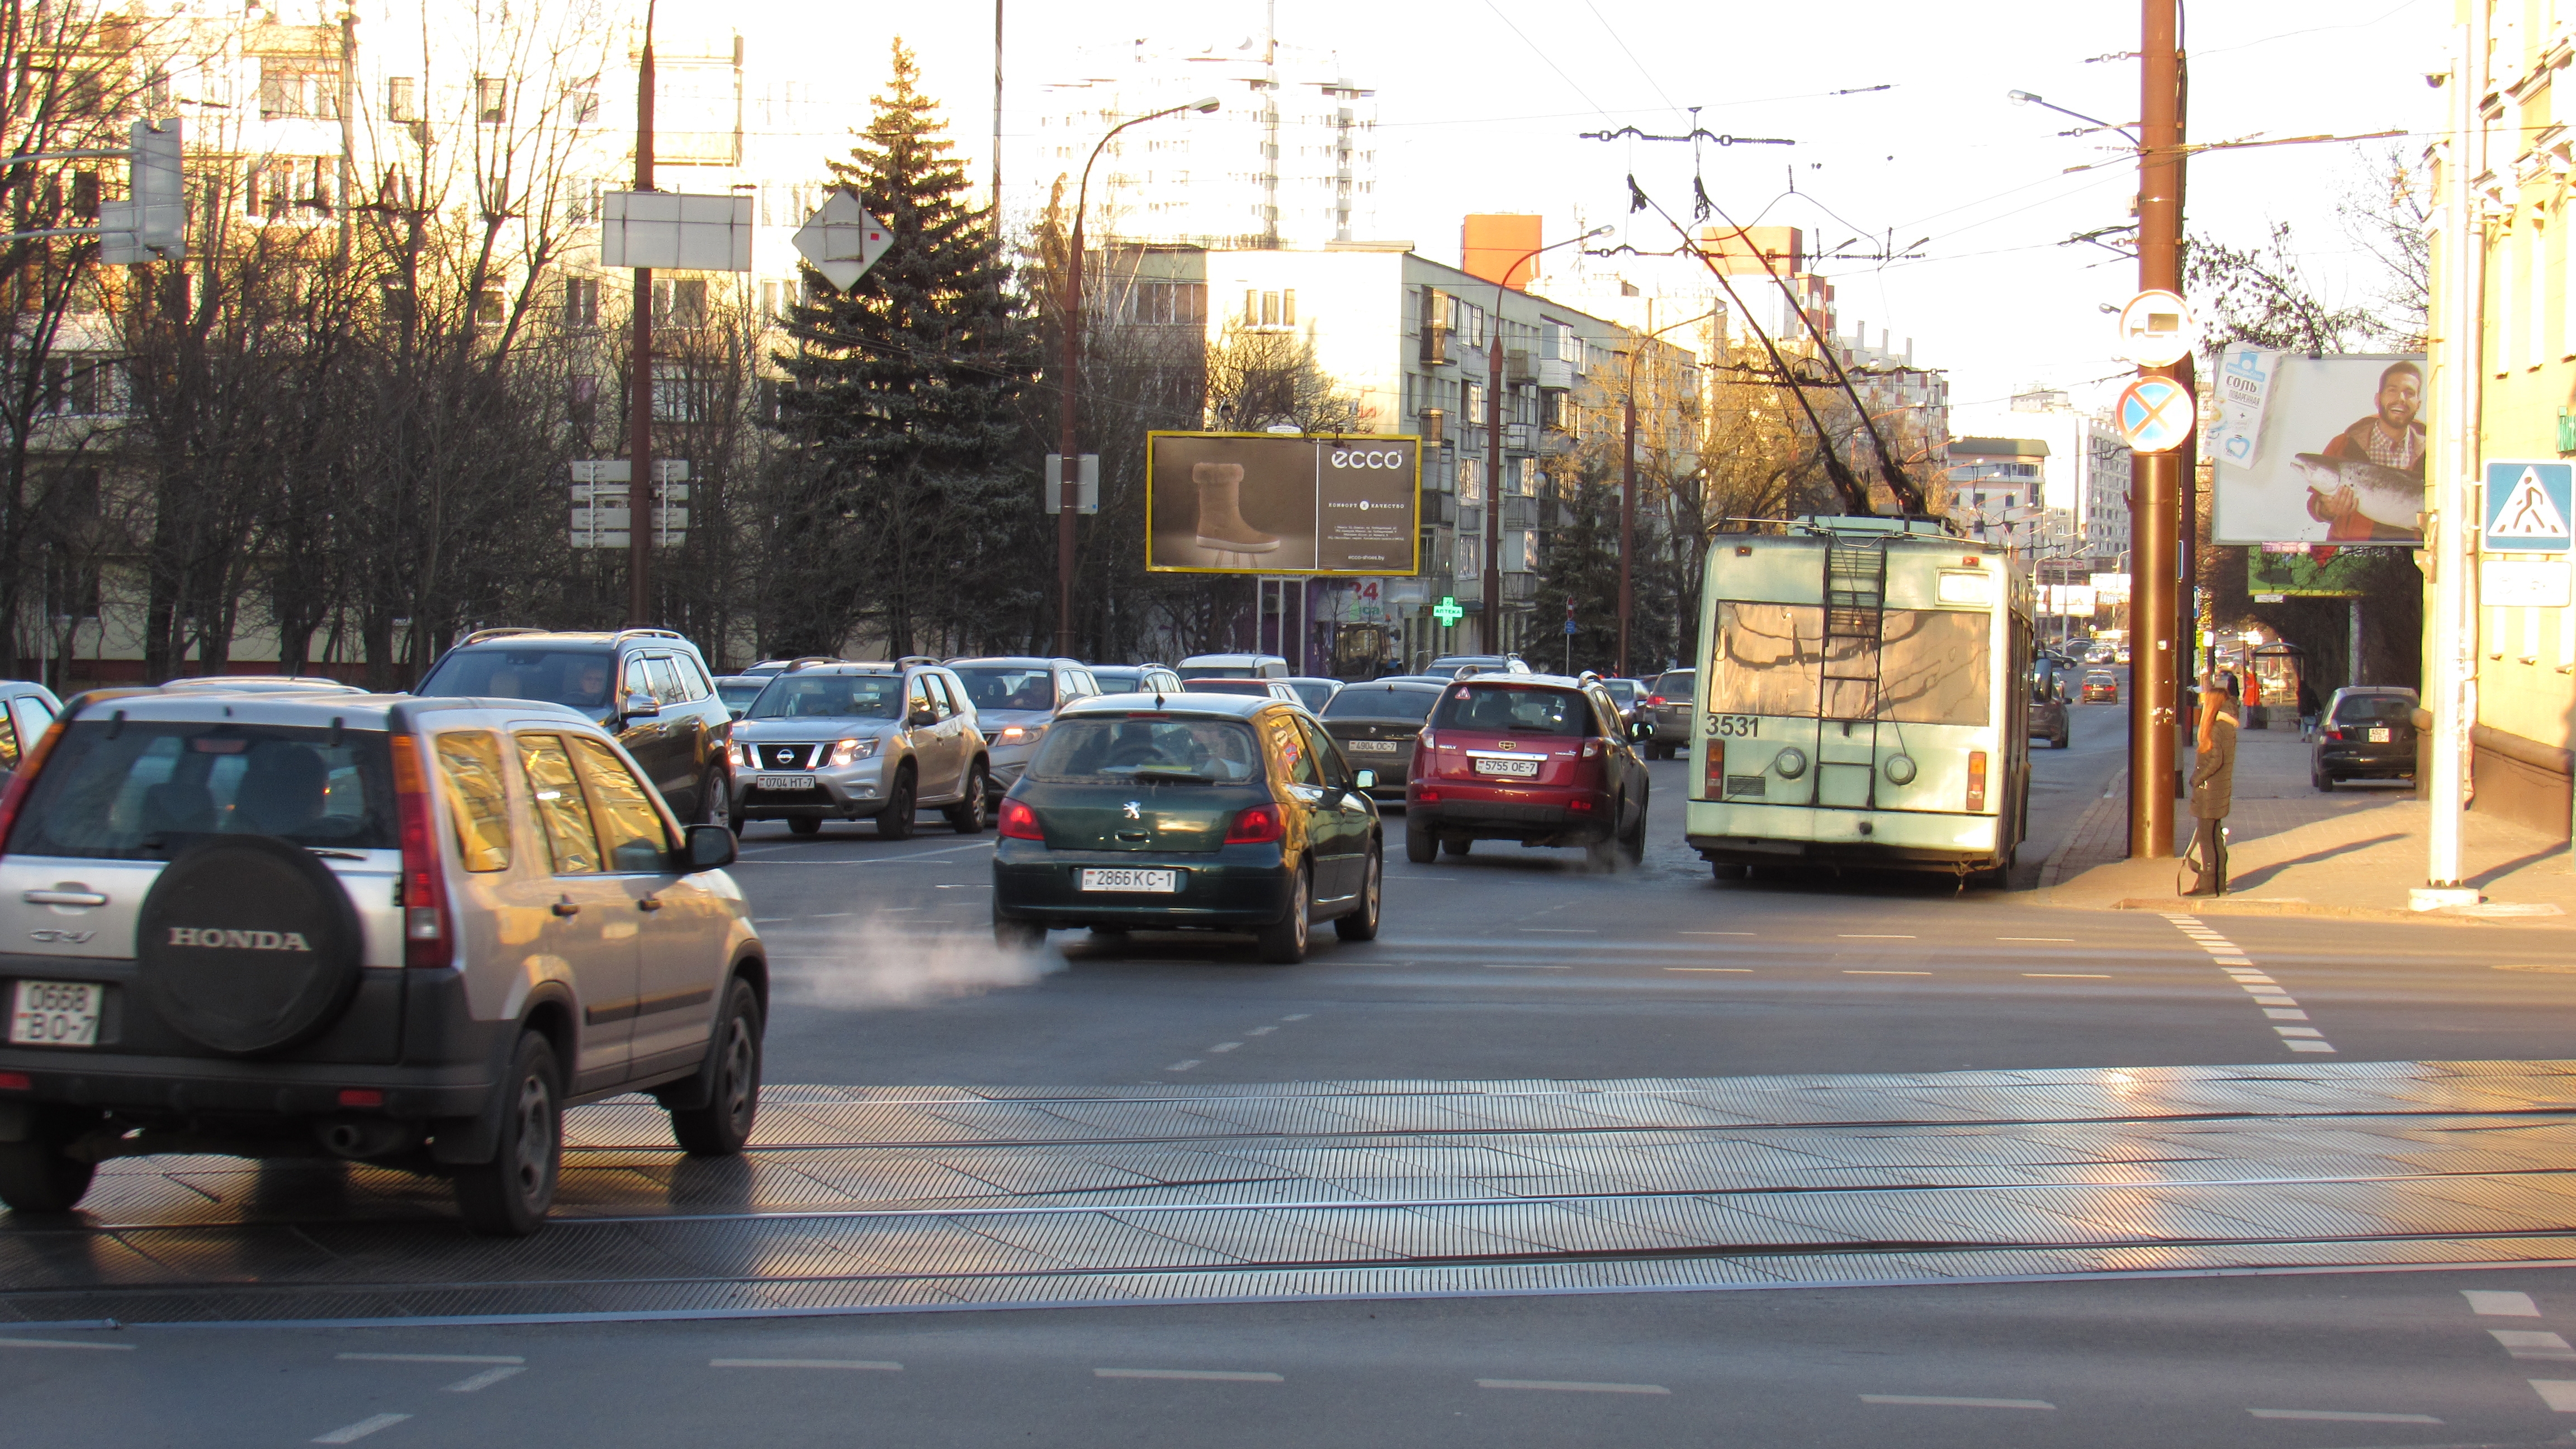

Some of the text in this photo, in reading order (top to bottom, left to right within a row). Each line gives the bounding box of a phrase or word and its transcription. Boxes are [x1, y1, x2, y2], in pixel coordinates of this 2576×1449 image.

[2225, 375, 2257, 392] СОЛЬ
[1331, 451, 1402, 469] ecco
[1706, 715, 1758, 737] 3531
[1485, 761, 1535, 773] 5755 OE-7
[766, 778, 812, 787] 0704 HT-7
[1097, 870, 1172, 887] 2866 KC-1
[168, 927, 312, 951] HONDA
[30, 984, 88, 1012] 0668
[30, 1012, 97, 1041] BO-7
